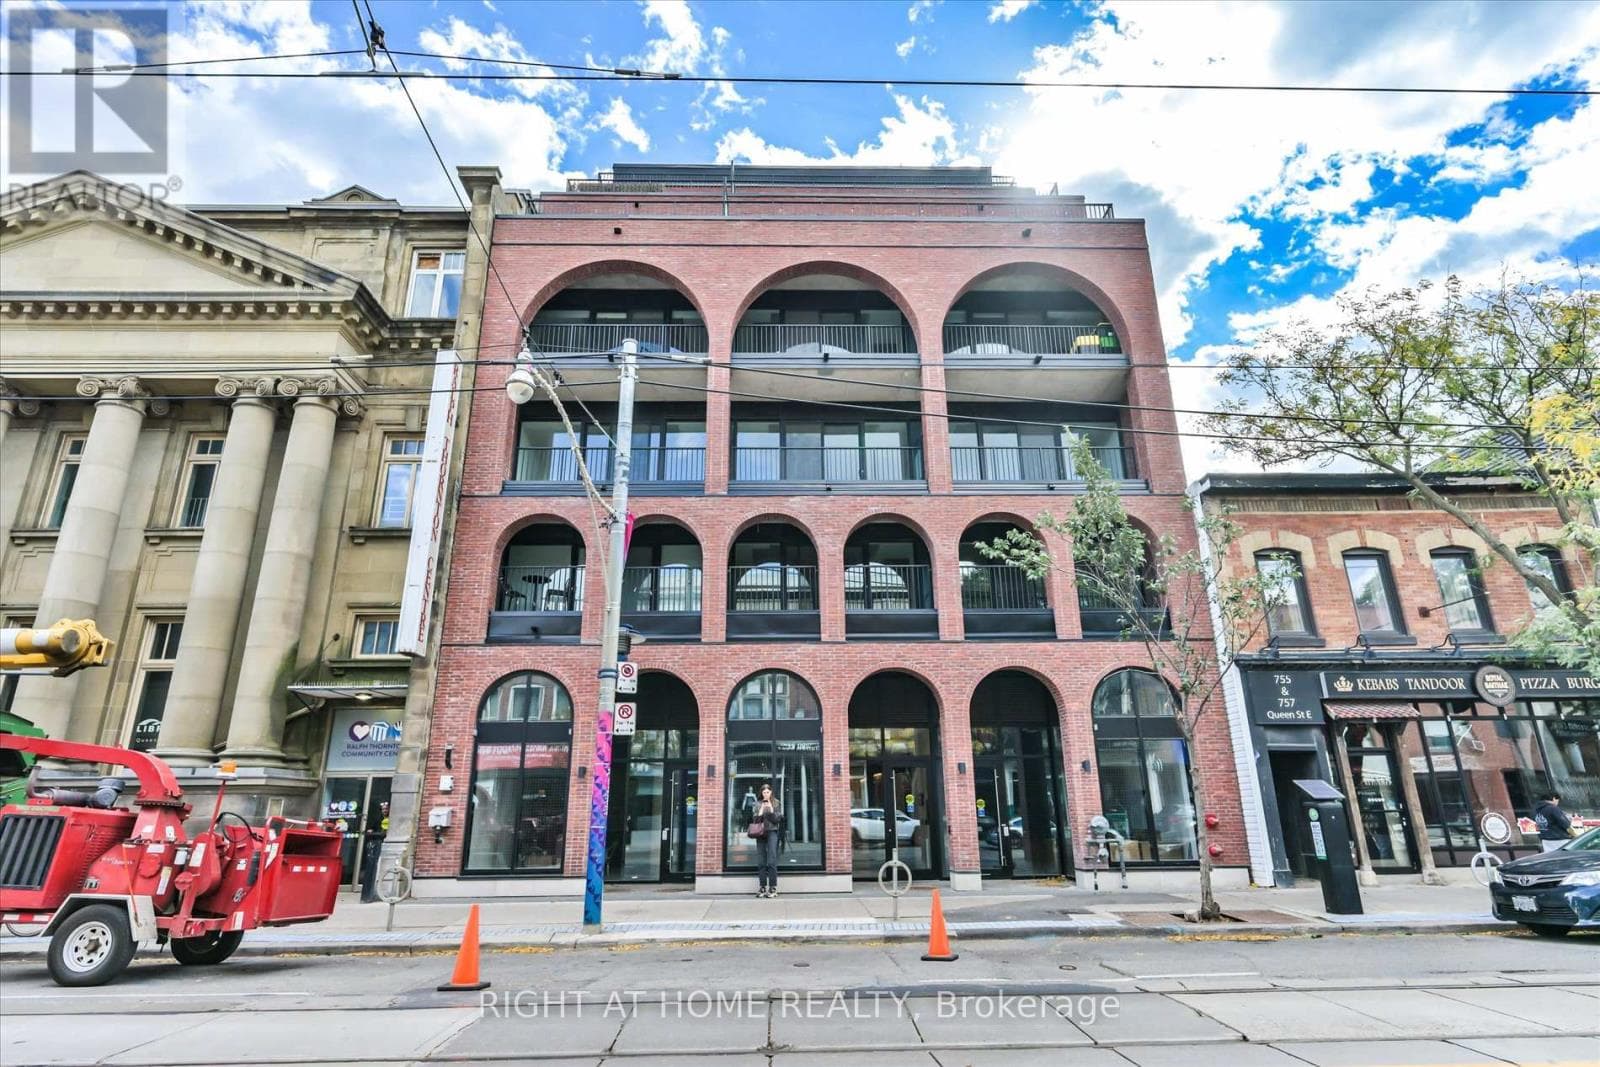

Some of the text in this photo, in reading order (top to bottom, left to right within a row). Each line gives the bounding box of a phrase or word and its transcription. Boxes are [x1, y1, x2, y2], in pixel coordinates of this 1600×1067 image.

[1273, 674, 1292, 685] 755
[1356, 677, 1467, 691] KEBABS TANDOOR
[1519, 677, 1560, 690] PIZZA
[1281, 686, 1290, 696] &
[1277, 698, 1296, 708] 757
[1266, 710, 1313, 720] Queen St E
